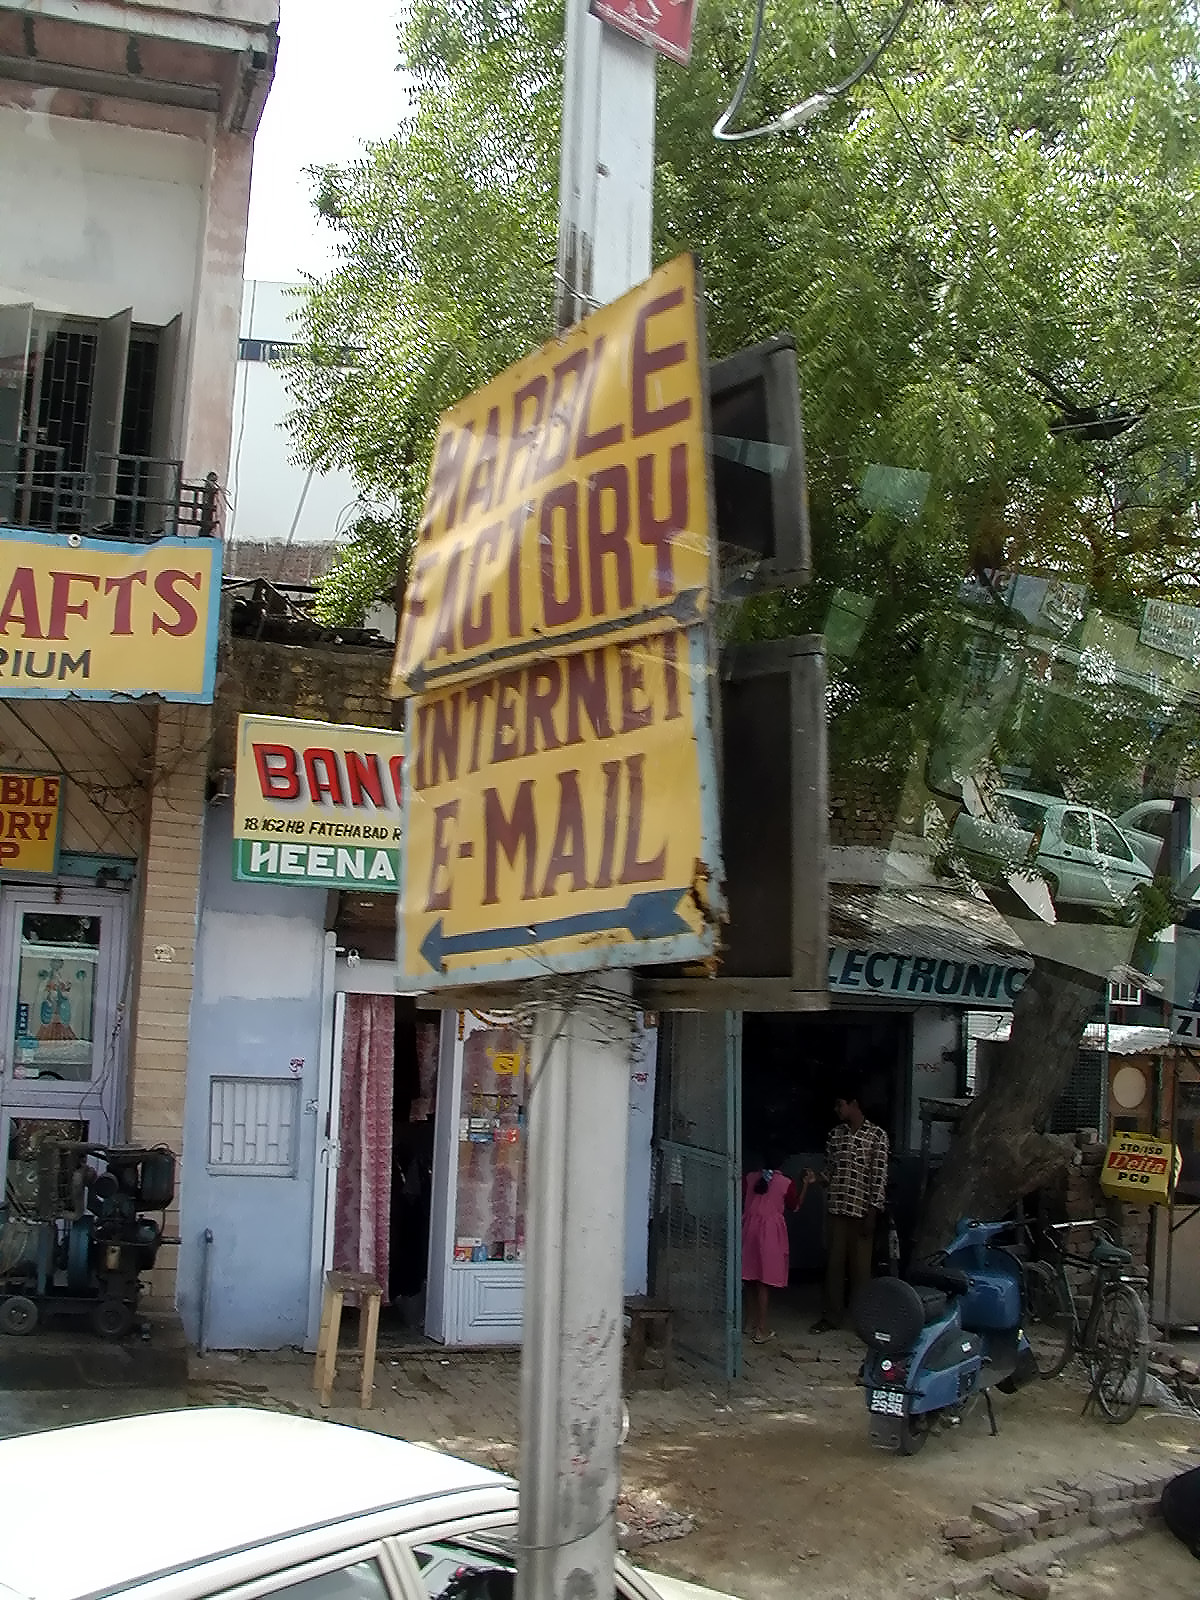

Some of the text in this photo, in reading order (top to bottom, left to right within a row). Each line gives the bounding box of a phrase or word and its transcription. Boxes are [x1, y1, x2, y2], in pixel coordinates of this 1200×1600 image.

[420, 286, 692, 541] MARBLE
[0, 567, 201, 640] AFTS
[400, 443, 690, 661] FACTORY
[415, 630, 683, 790] INTERNET
[250, 842, 396, 881] HEENA
[308, 821, 389, 840] FATEHABAD
[424, 753, 667, 913] E-MAIL
[1120, 1143, 1163, 1154] STD/ISD
